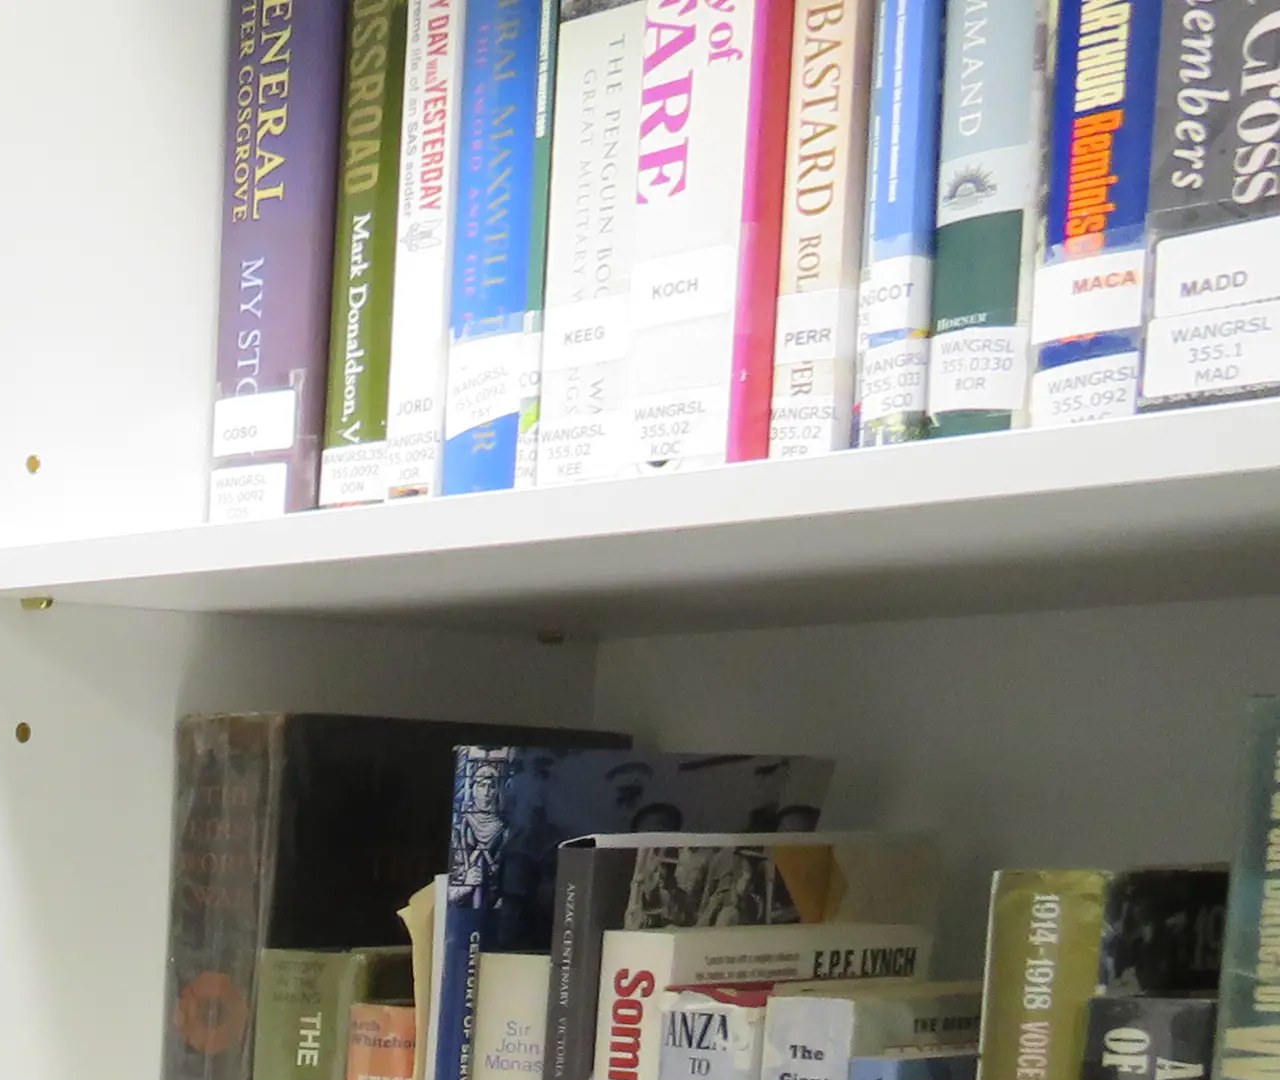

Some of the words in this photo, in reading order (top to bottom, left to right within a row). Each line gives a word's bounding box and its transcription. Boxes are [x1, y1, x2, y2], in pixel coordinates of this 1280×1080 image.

[425, 14, 450, 56] DAY
[605, 33, 626, 97] THE
[578, 68, 598, 147] GREAT
[795, 3, 843, 217] BASTARD
[233, 66, 255, 222] COSGROVE
[419, 80, 446, 211] YESTERDAY
[597, 108, 622, 235] PENGUIN
[571, 159, 594, 278] MILITARY
[349, 212, 372, 279] Mark
[239, 255, 264, 318] MY
[650, 277, 700, 301] KOCH
[1071, 270, 1138, 296] MACA
[1179, 270, 1248, 298] MADD
[563, 325, 606, 346] KEEG
[784, 327, 832, 348] PERR
[1171, 316, 1272, 344] WANGRSL
[940, 338, 1015, 356] WANGRSL
[1047, 366, 1140, 395] WANGRSL
[1193, 365, 1239, 384] MAD
[634, 400, 707, 423] WANGRSL
[540, 423, 607, 445] WANGRSL
[649, 441, 683, 458] KOC
[556, 461, 583, 477] KEE
[558, 930, 573, 1009] CENTENARY
[860, 946, 918, 976] LYNCH
[296, 1012, 323, 1068] THE
[505, 1020, 531, 1037] Sir
[495, 1037, 540, 1056] John
[553, 1016, 567, 1078] VICTORIA
[789, 1044, 825, 1062] The
[1100, 1026, 1151, 1077] OF
[688, 1057, 711, 1076] TO
